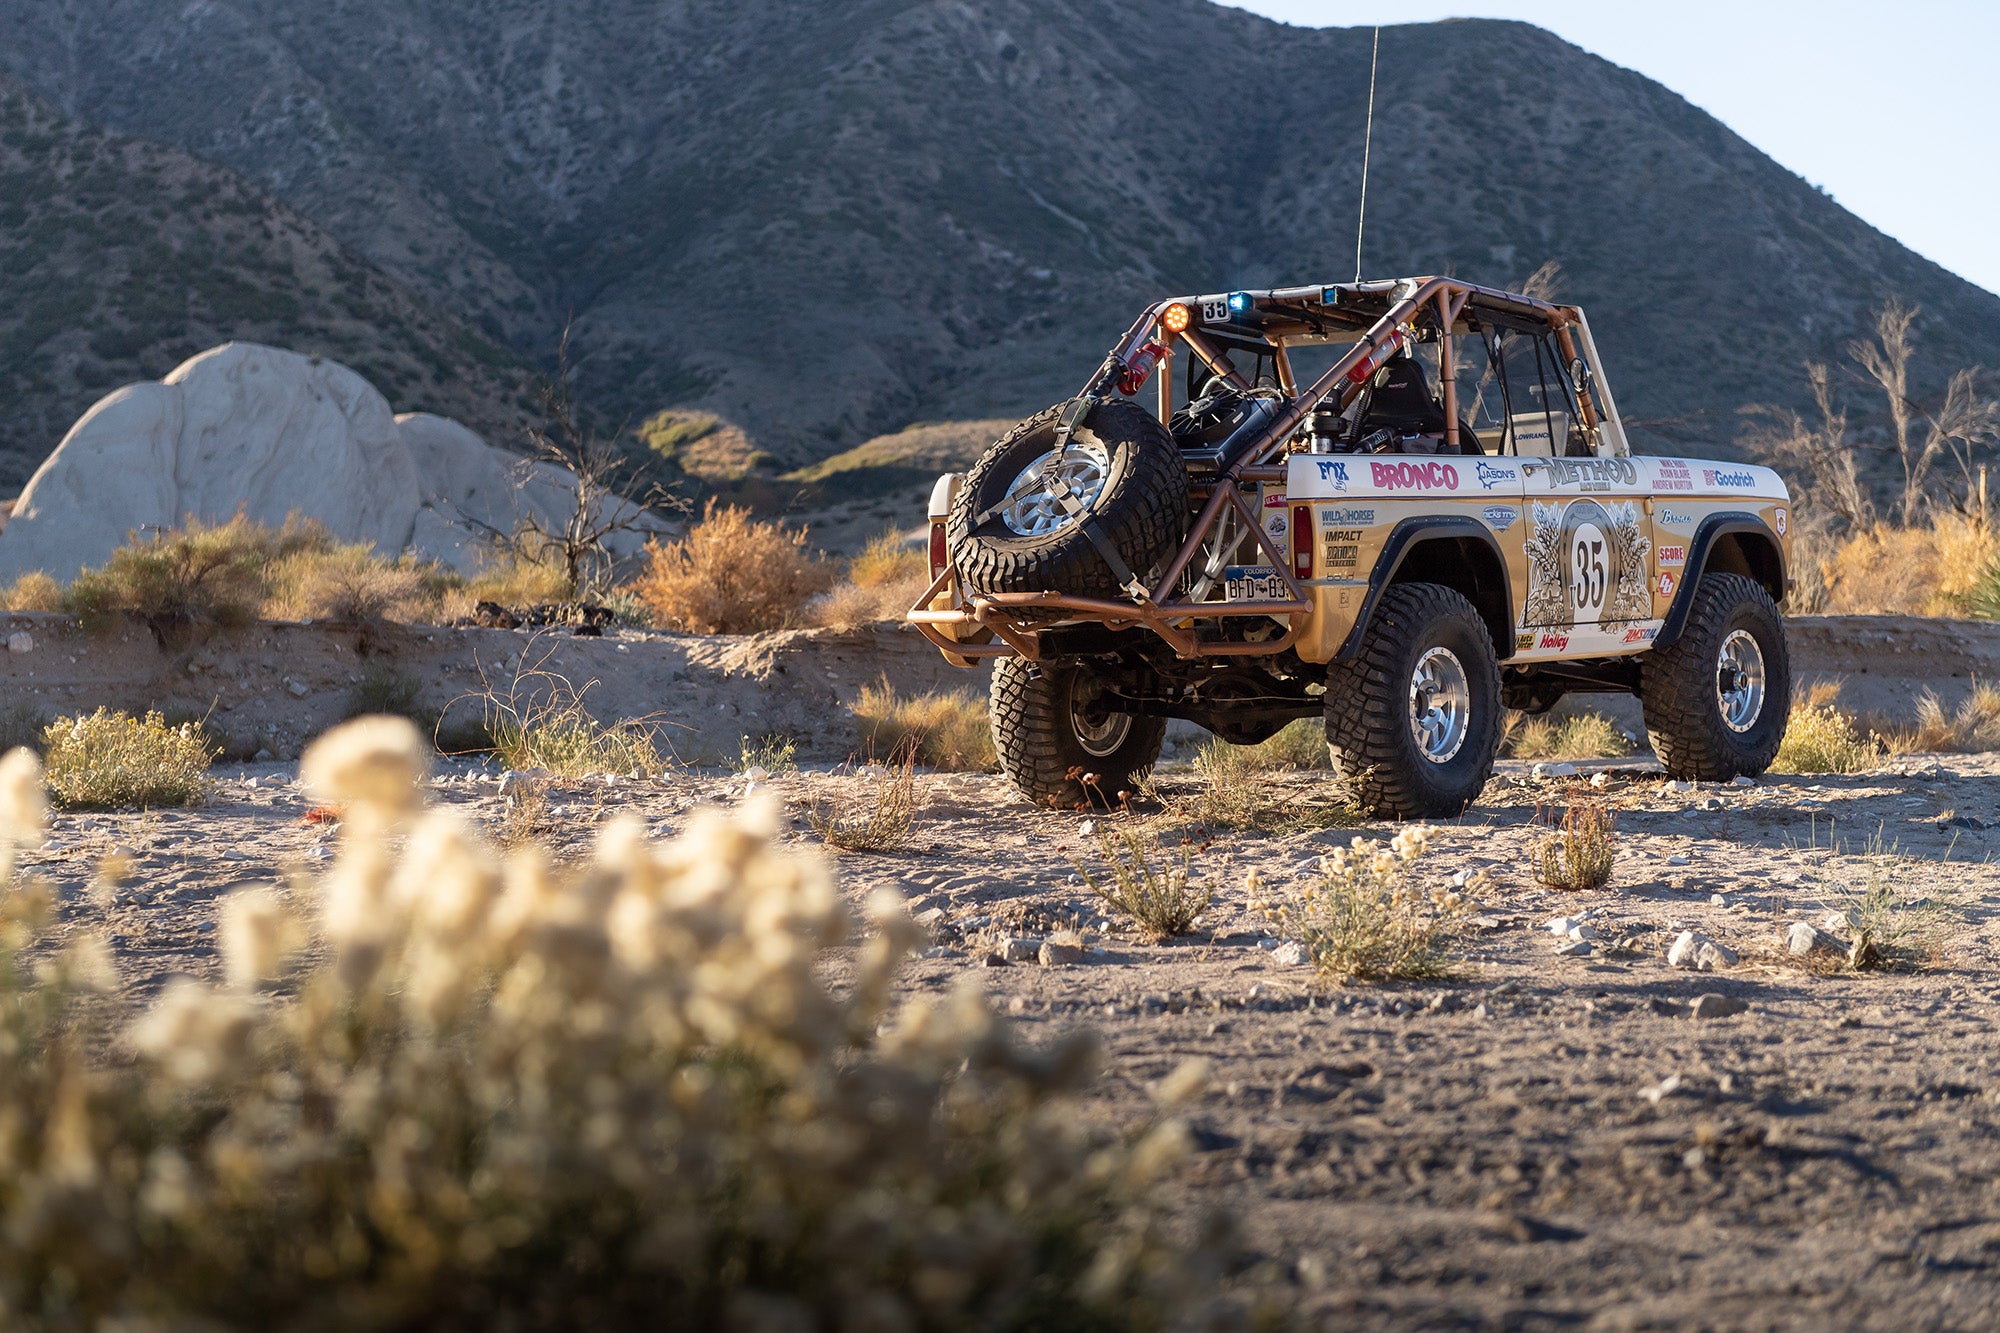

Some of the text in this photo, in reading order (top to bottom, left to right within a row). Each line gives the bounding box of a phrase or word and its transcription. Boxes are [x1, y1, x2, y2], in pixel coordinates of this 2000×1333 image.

[1205, 301, 1227, 319] 35
[1317, 461, 1349, 482] FOX
[1370, 461, 1459, 490] BRONCO
[1481, 470, 1516, 479] JASON'S
[1543, 458, 1637, 489] METHOD
[1703, 469, 1755, 488] BFGoodrich
[1652, 479, 1673, 490] ANDREW
[1322, 509, 1375, 521] WILD HORSES
[1325, 530, 1363, 542] IMPACT
[1660, 547, 1683, 560] SCORE
[1229, 578, 1254, 598] BFD
[1540, 634, 1569, 652] Holley
[1622, 629, 1656, 643] AMSOIL
